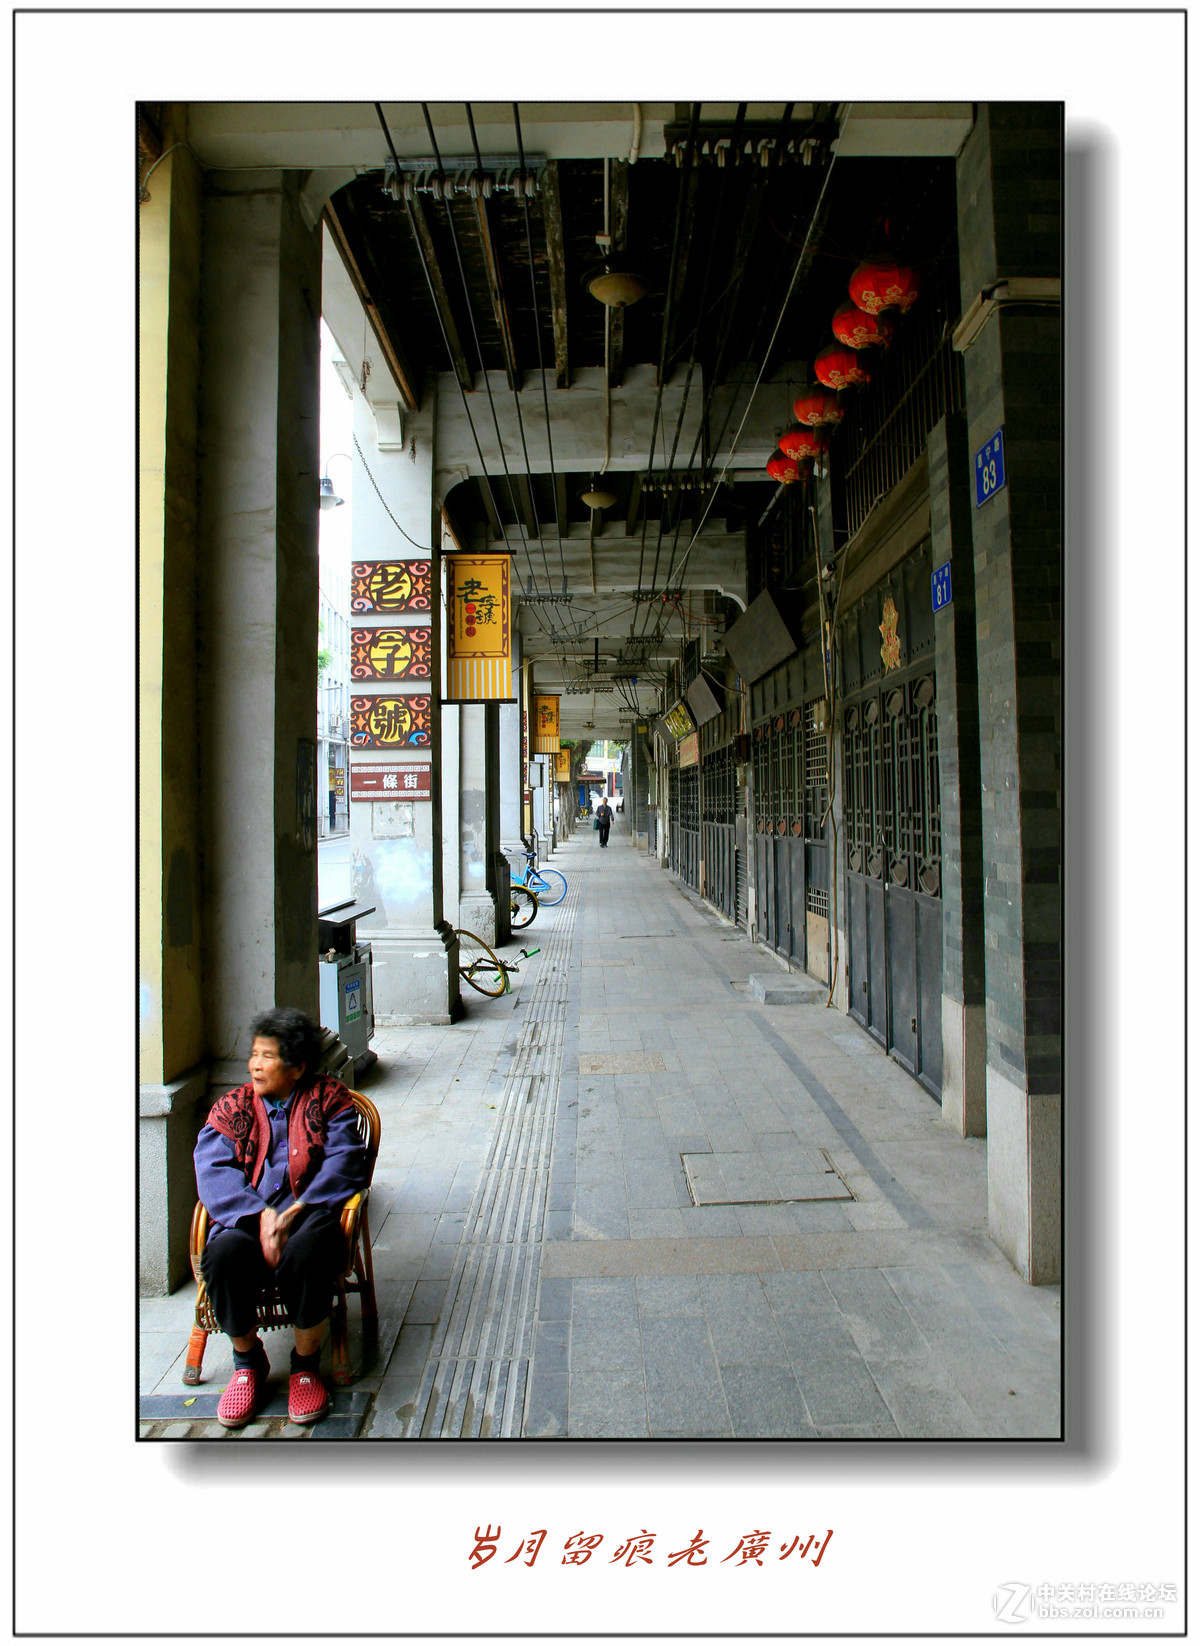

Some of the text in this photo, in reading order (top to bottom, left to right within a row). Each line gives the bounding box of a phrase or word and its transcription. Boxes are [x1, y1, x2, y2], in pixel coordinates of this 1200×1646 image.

[983, 459, 997, 494] 83
[937, 580, 947, 605] 81
[363, 773, 418, 789] 一條街
